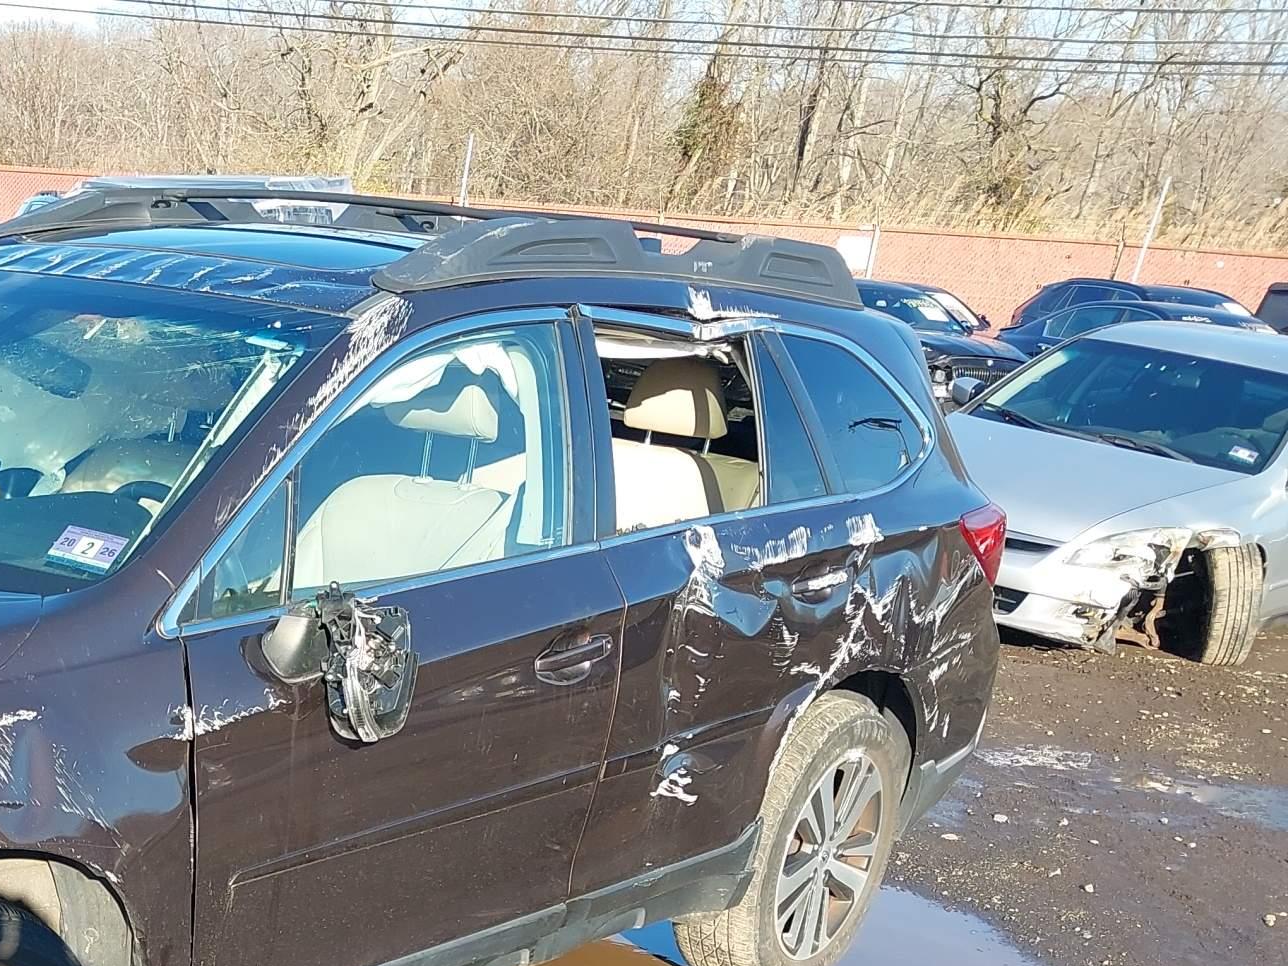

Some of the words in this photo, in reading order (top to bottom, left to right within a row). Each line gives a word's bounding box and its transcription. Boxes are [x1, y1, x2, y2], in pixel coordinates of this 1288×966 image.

[60, 537, 77, 547] 20
[80, 541, 95, 555] 2
[99, 547, 118, 558] 26
